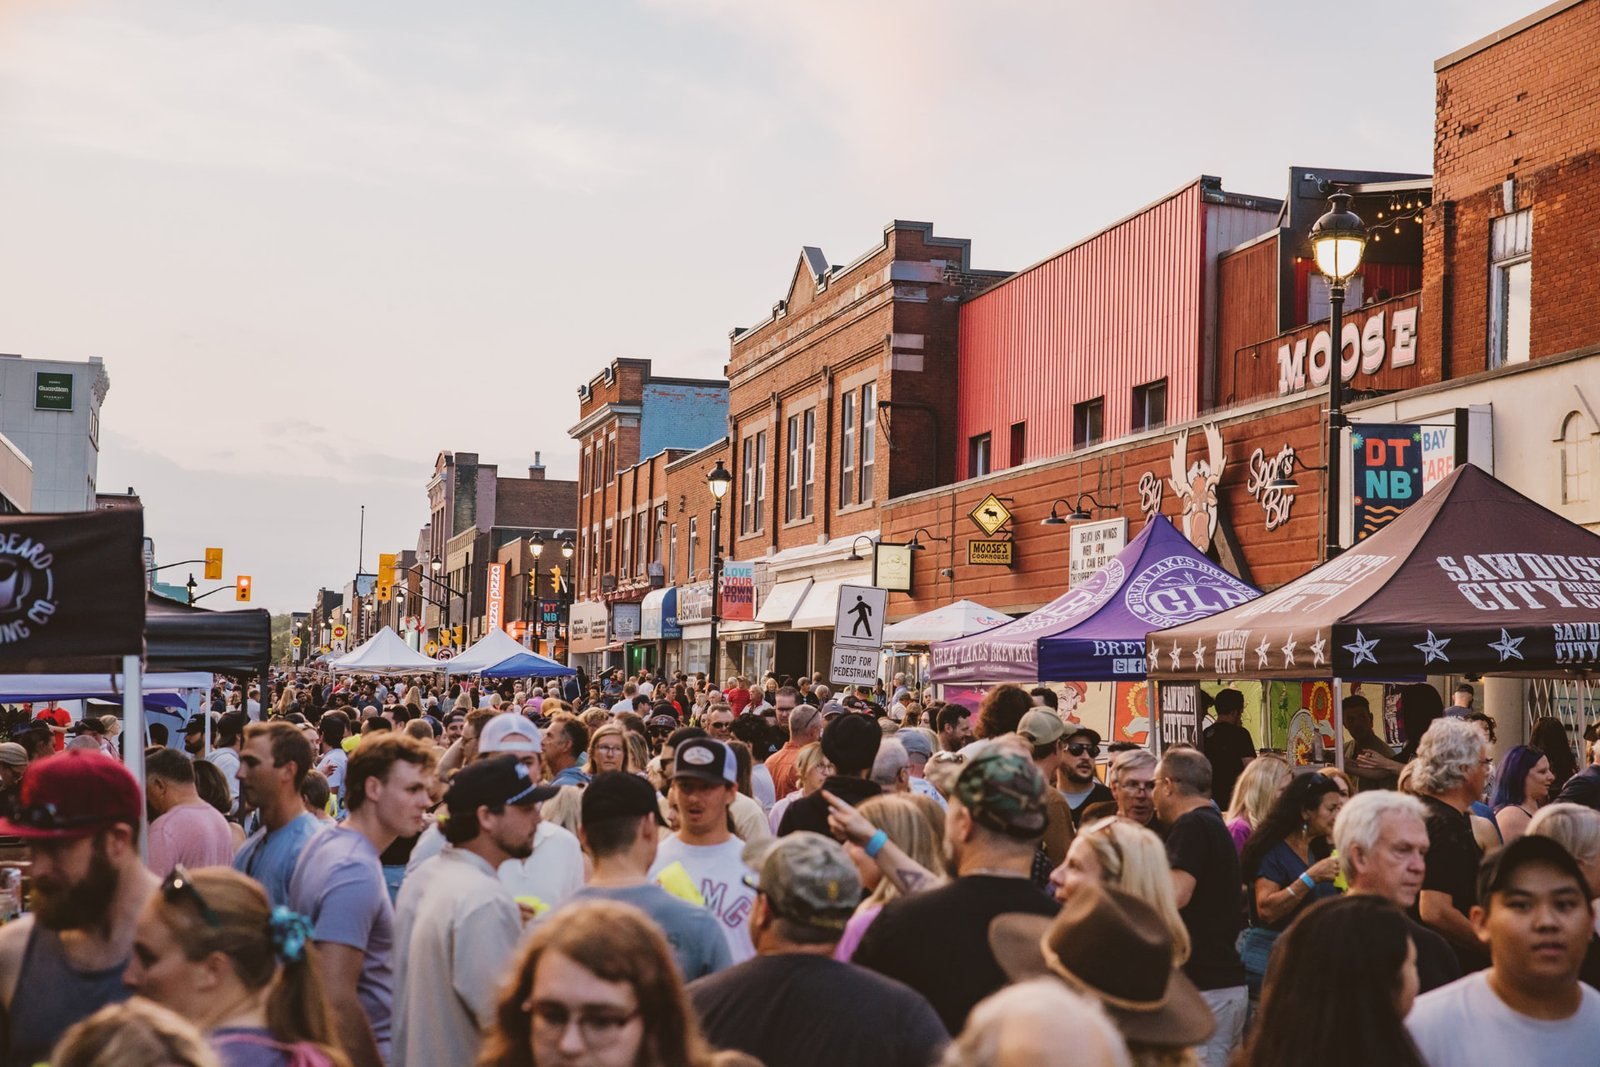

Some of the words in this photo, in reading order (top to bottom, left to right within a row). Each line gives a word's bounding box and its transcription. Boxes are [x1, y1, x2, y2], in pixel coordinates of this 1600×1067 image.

[1276, 306, 1418, 397] MOOSE
[1365, 438, 1411, 467] DT
[1423, 428, 1448, 453] BAY
[1138, 471, 1163, 514] Big
[1365, 470, 1412, 499] NB
[1262, 487, 1294, 529] Bar
[973, 543, 1008, 553] MOOSE'S
[490, 565, 502, 599] pizza
[725, 568, 753, 577] LOVE
[725, 577, 753, 586] YOUR
[1128, 574, 1152, 604] GREAT
[1148, 557, 1195, 578] LAKES
[724, 586, 754, 595] DOWN
[724, 595, 753, 603] TOWN
[1457, 580, 1583, 611] CITY
[1560, 581, 1600, 593] BRE
[543, 603, 557, 613] DT
[543, 613, 557, 621] NB
[840, 654, 857, 665] STOP
[859, 655, 872, 667] FOR
[933, 646, 960, 668] GREAT
[961, 641, 989, 664] LAKES
[990, 640, 1034, 663] BREWERY
[833, 666, 876, 680] PEDESTRIANS
[1162, 686, 1194, 712] SAWDUST
[1163, 713, 1182, 744] CITY
